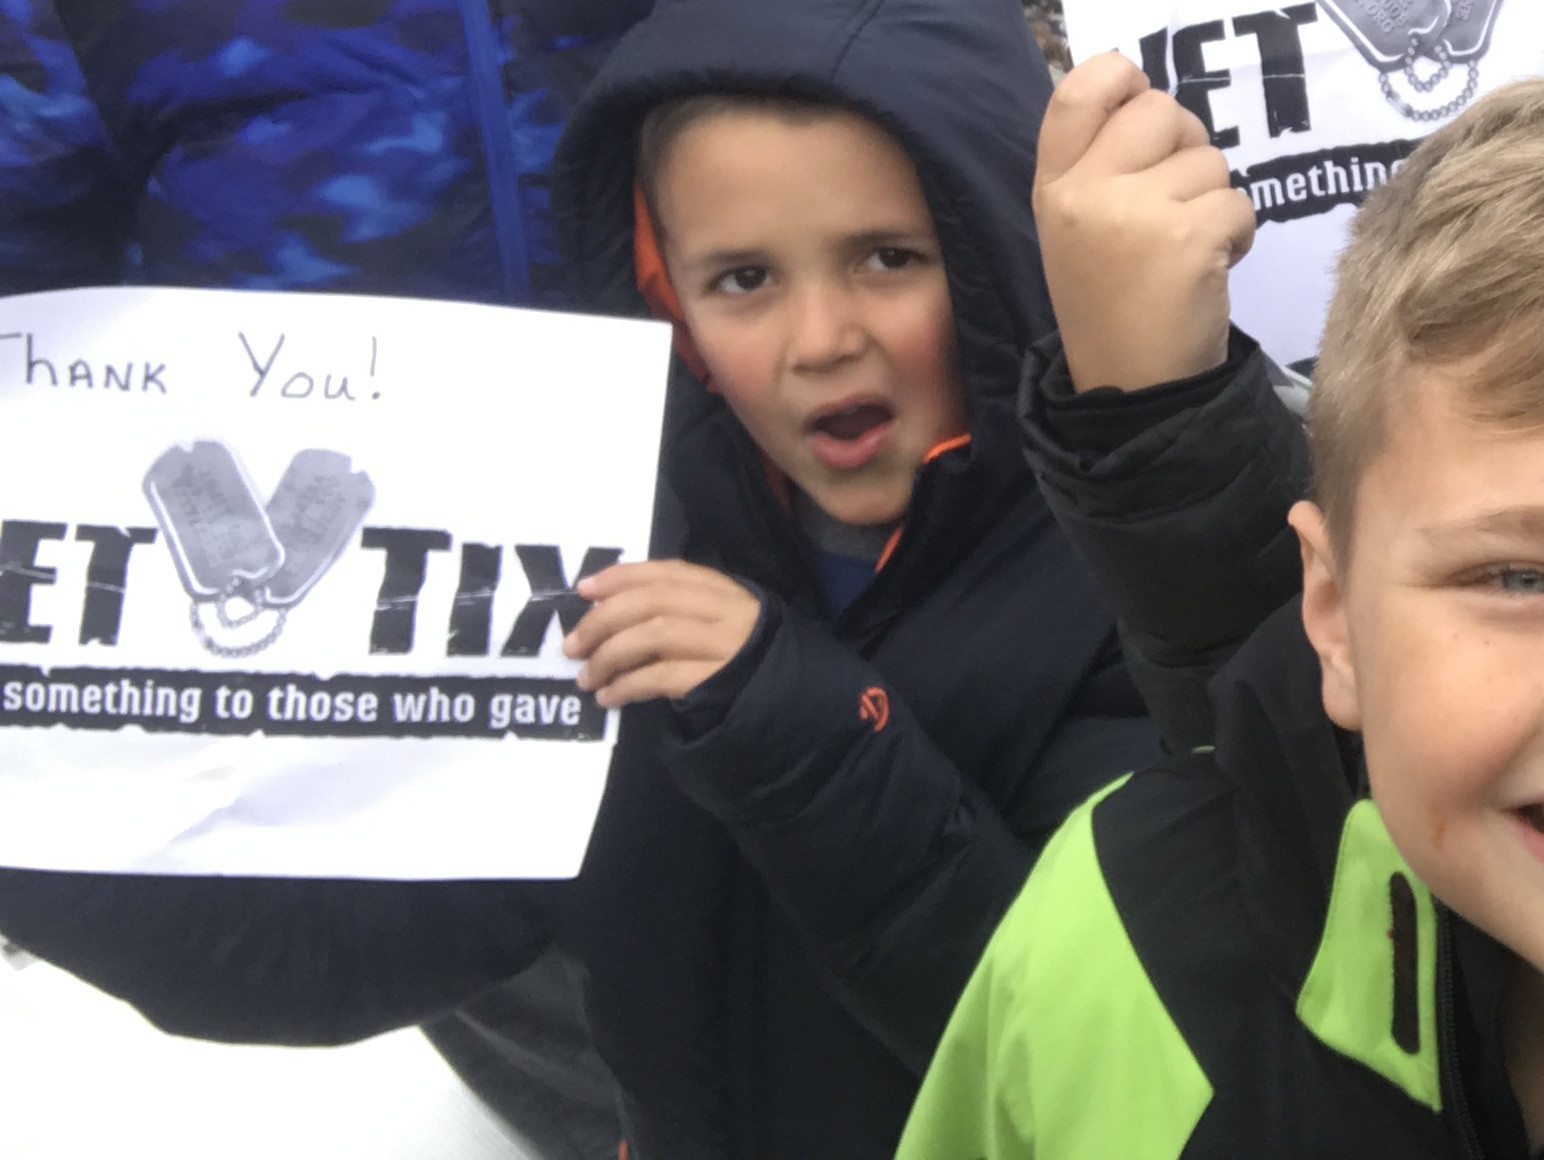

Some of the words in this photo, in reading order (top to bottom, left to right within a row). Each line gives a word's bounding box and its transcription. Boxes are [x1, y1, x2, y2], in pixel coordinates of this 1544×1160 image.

[361, 526, 624, 658] TIX
[3, 677, 203, 722] something
[215, 685, 254, 719] to
[267, 685, 378, 722] those
[392, 687, 476, 722] who
[489, 692, 582, 729] gave
